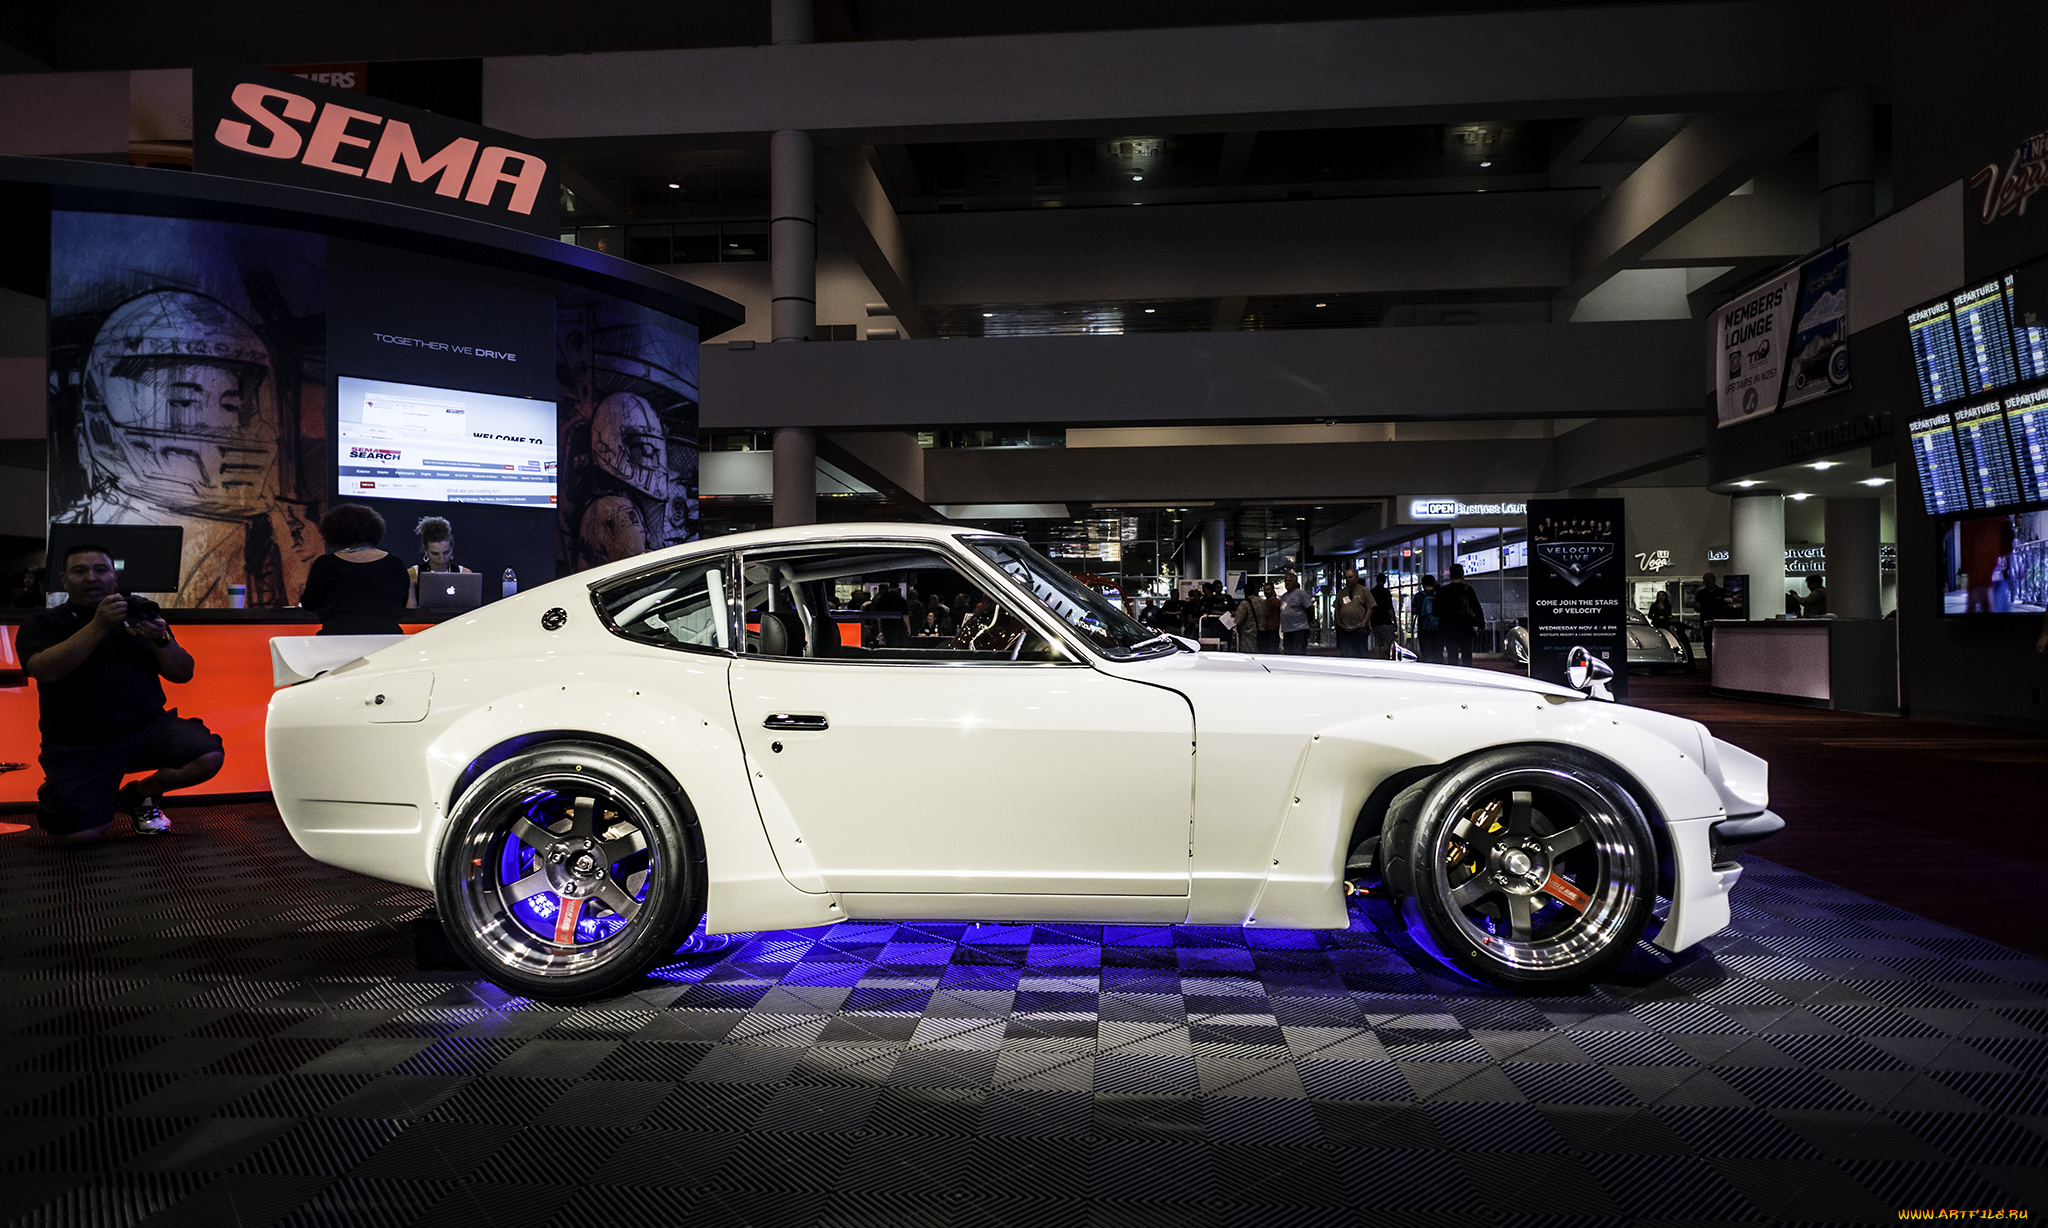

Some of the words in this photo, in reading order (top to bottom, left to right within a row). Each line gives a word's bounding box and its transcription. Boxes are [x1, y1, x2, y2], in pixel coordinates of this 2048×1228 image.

[214, 82, 548, 215] SEMA
[1969, 149, 2048, 225] Vega
[1953, 280, 2000, 306] DEPARTURES
[1725, 282, 1787, 330] MEMBERS'
[1907, 300, 1950, 324] DEPARTURES
[1725, 314, 1773, 350] LOUNGE
[373, 332, 449, 351] TOGETHER
[451, 344, 473, 355] WE
[475, 348, 517, 361] DRIVE
[1725, 376, 1752, 394] UPSTAIRS
[1754, 374, 1760, 385] IN
[1761, 368, 1777, 380] N251
[1909, 413, 1951, 431] DEPARTURES
[1954, 402, 2001, 421] DEPARTURES
[350, 452, 400, 460] SEARCH
[1429, 504, 1454, 514] OPEN
[1456, 502, 1500, 514] Business
[1546, 546, 1605, 554] VELOCITY
[1707, 549, 1730, 561] Las
